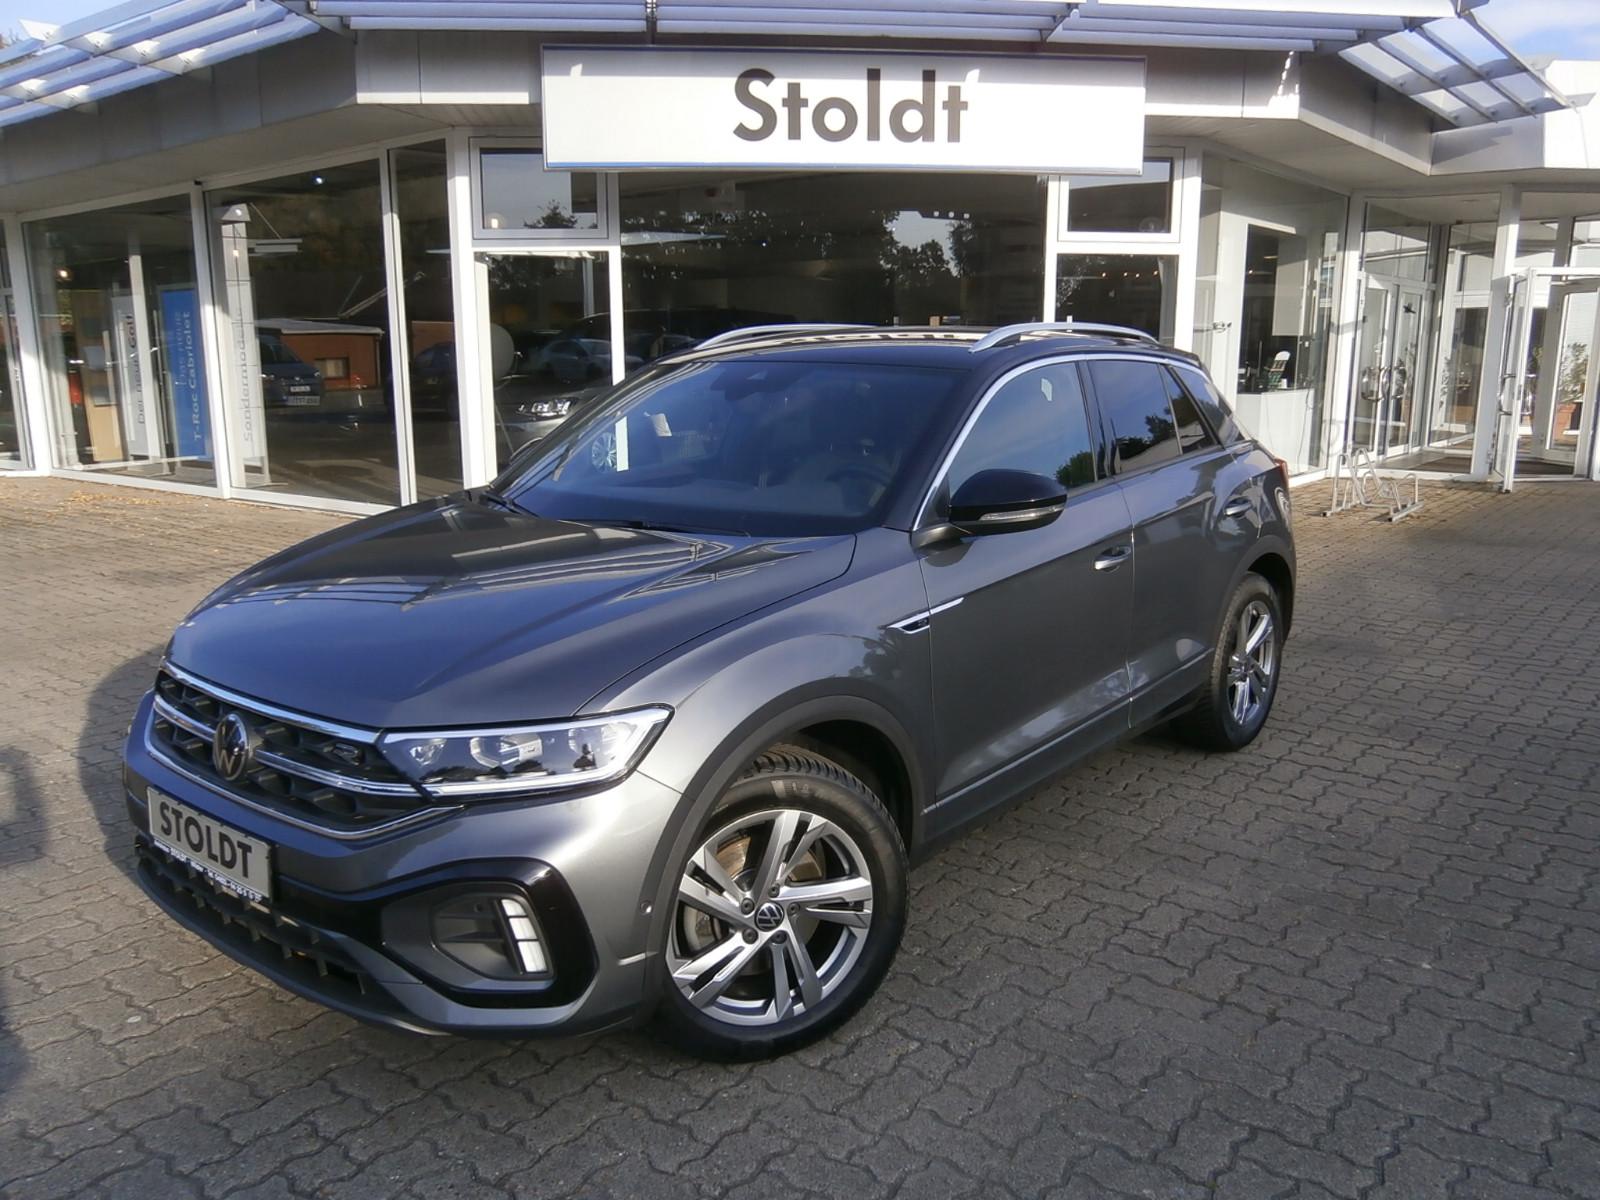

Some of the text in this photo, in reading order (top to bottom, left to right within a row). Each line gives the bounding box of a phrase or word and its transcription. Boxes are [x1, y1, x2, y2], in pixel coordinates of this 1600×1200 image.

[732, 67, 969, 143] Stoldt
[126, 315, 137, 349] Golf
[183, 311, 202, 441] T-Roc Cabriolet
[159, 801, 252, 878] STOLDT
